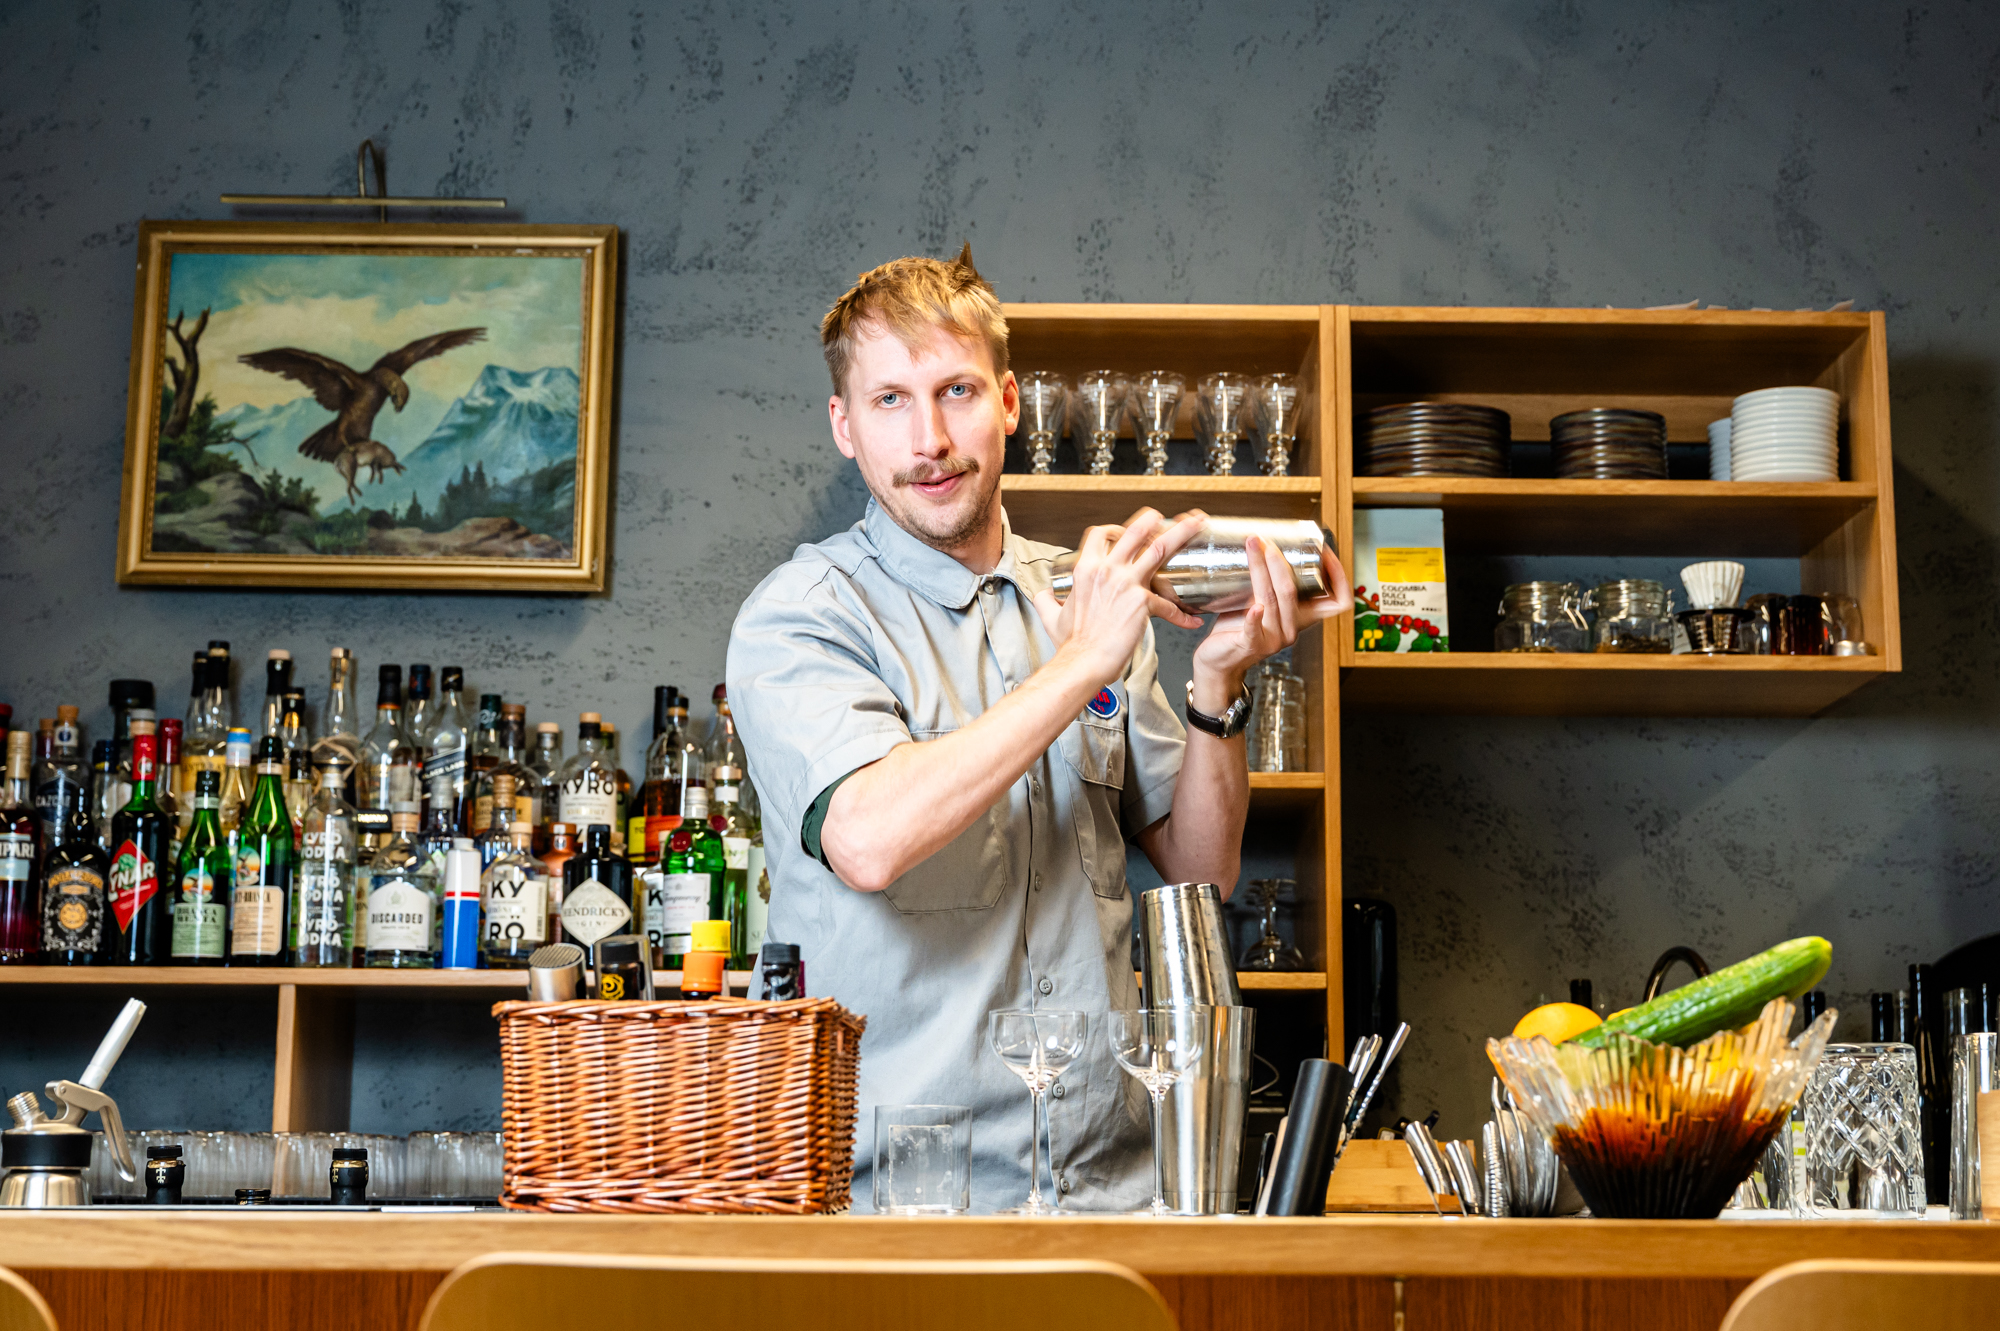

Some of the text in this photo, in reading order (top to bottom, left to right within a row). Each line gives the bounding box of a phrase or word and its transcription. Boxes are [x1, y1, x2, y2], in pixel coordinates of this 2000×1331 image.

[108, 861, 155, 902] CYNAR
[490, 880, 526, 898] KY
[371, 913, 424, 924] DISCARDED
